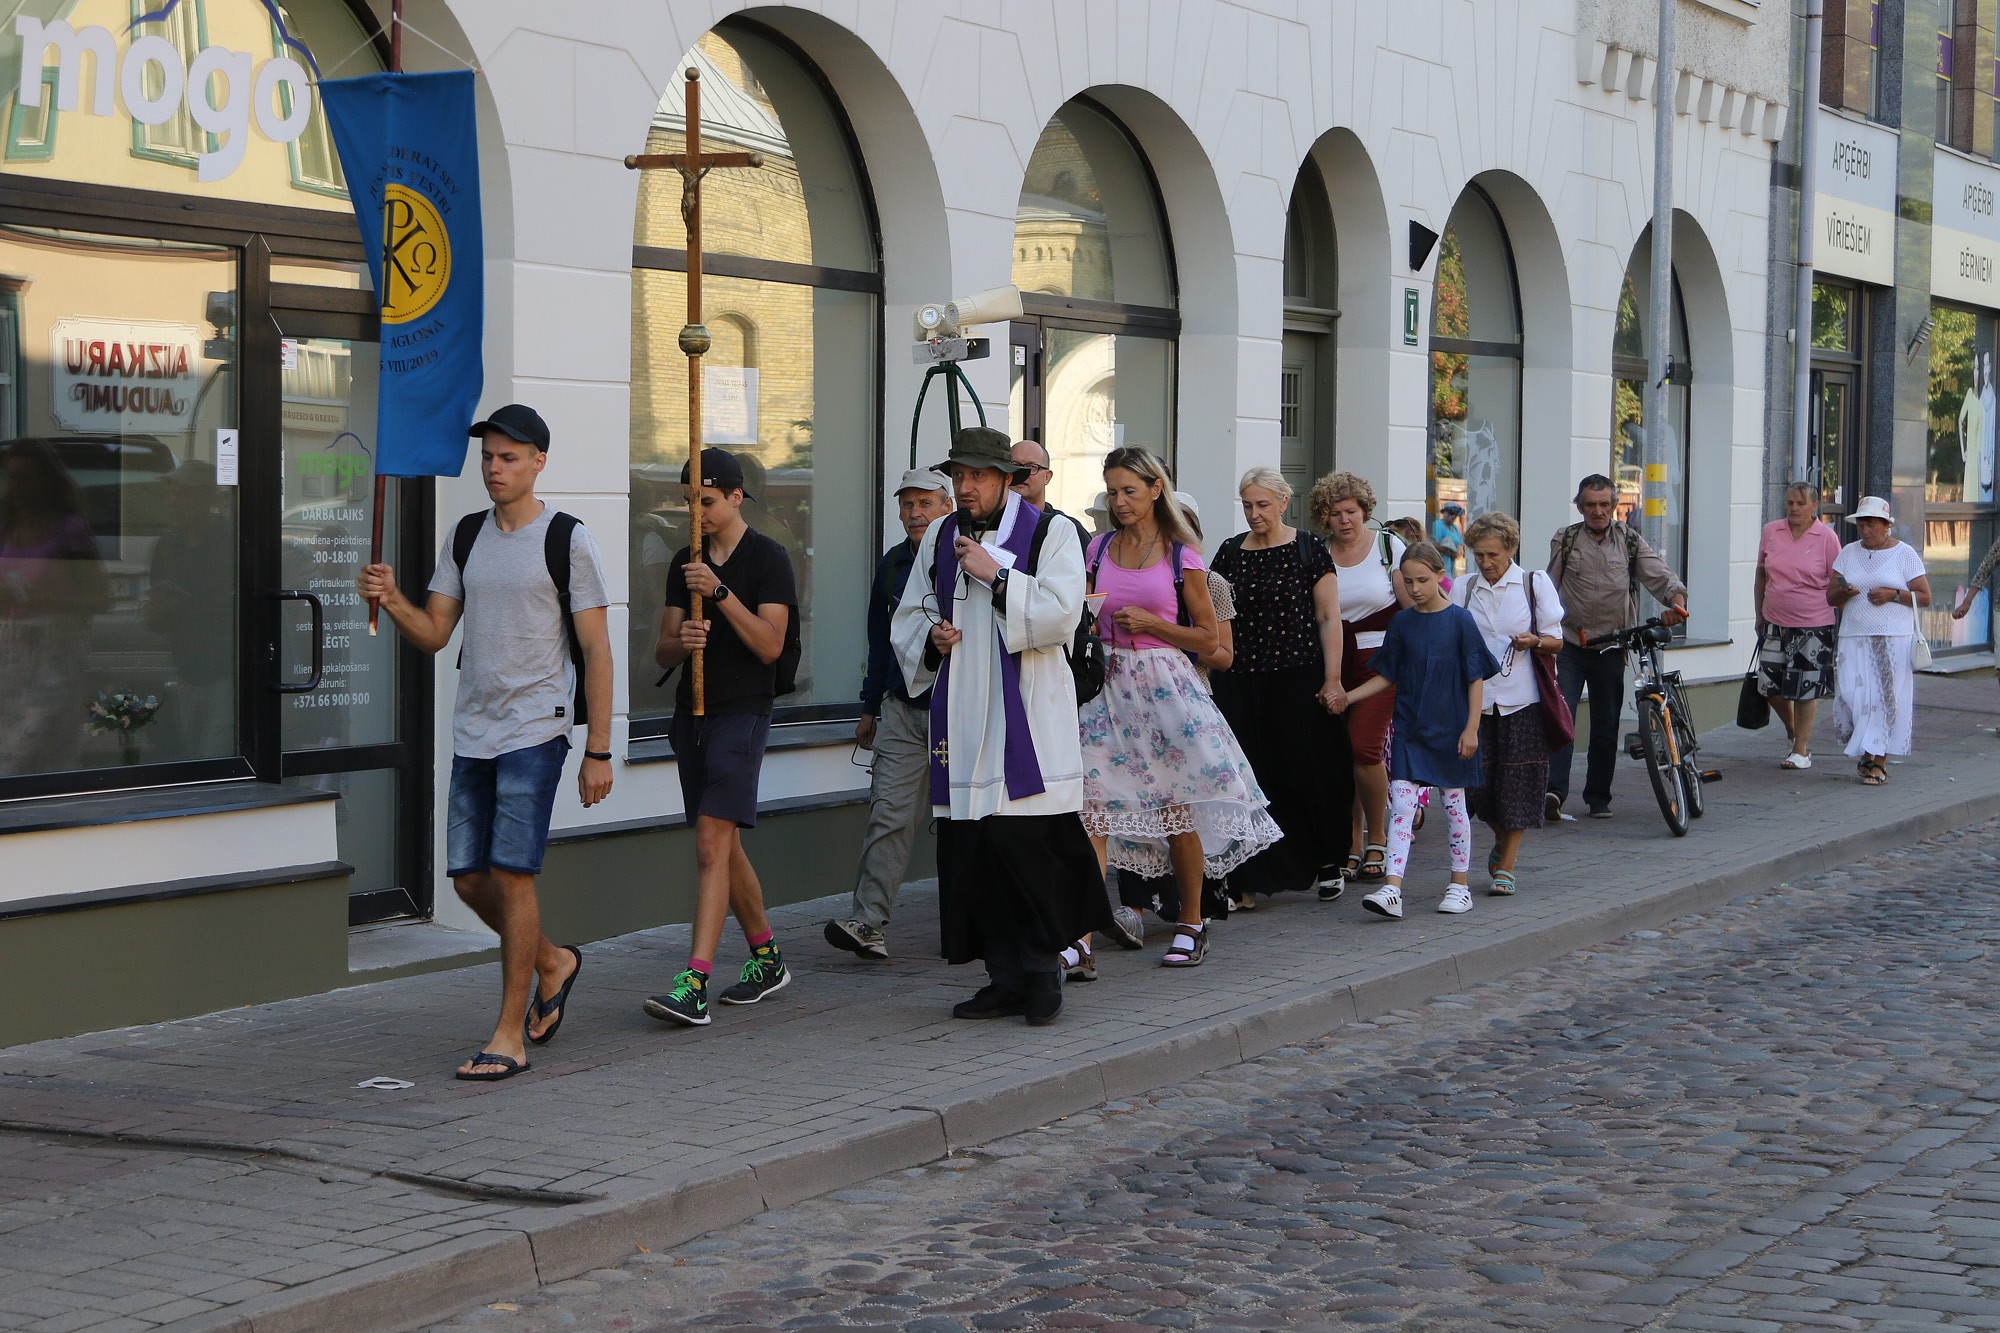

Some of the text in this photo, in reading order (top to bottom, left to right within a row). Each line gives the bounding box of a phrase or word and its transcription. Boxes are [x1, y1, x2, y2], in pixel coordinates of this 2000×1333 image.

[15, 14, 312, 183] mogo
[1832, 140, 1872, 183] APĢĒRBI
[1962, 182, 1994, 220] APĢĒRBI
[1826, 212, 1872, 256] VĪRIEŠIEM
[1960, 247, 1993, 284] BĒRNIEM
[1410, 304, 1414, 331] 1
[390, 320, 445, 349] AGLONA
[299, 452, 370, 489] mogo
[302, 508, 364, 521] DARBA LAIKS
[309, 577, 356, 589] pārtraukums
[333, 620, 368, 630] svētdiena
[293, 692, 370, 709] +371 66 900 900
